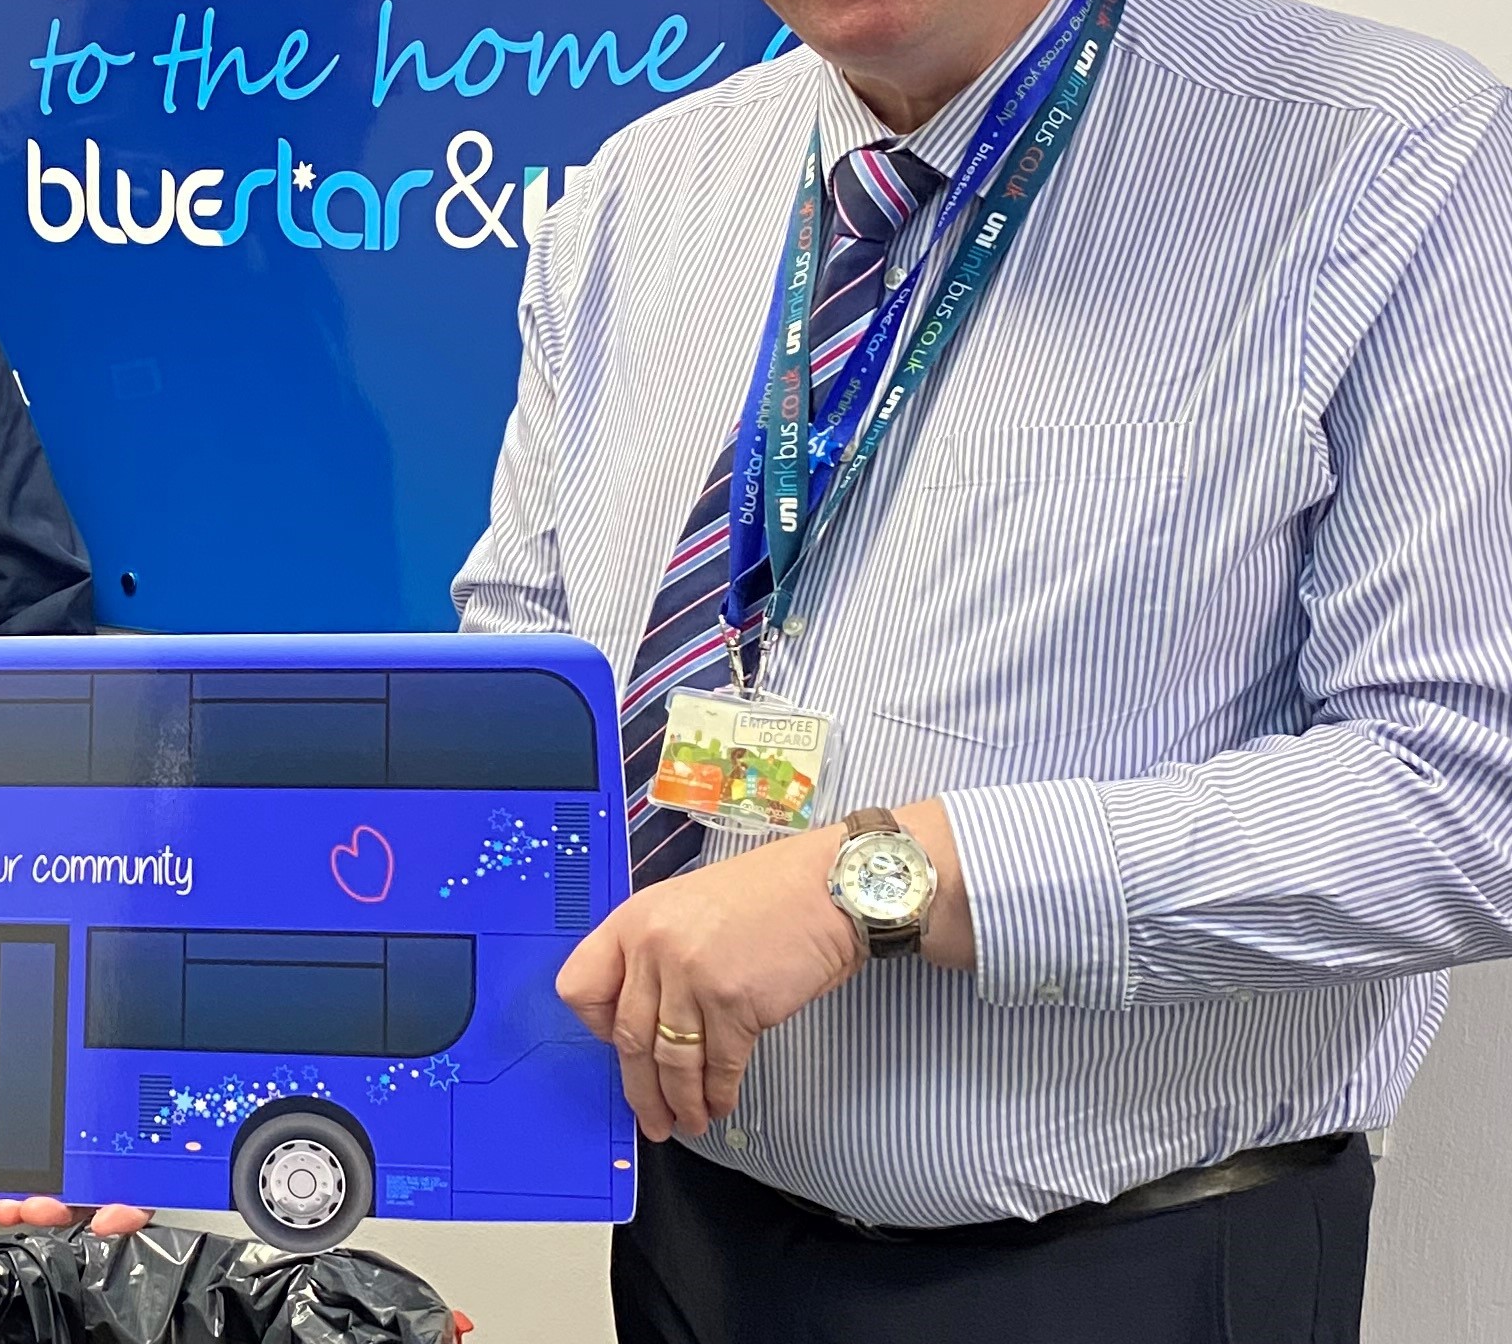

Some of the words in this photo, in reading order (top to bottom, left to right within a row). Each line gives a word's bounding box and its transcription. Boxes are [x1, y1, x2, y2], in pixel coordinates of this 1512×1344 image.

[30, 18, 135, 115] to
[153, 7, 339, 114] the
[372, 0, 726, 109] home
[1037, 30, 1073, 71] across
[1015, 67, 1041, 100] your
[995, 99, 1018, 127] city
[937, 142, 995, 228] bluestarbus
[865, 287, 911, 362] bluestar
[827, 376, 862, 426] shining
[739, 448, 763, 525] bluestar
[740, 717, 813, 733] EMPLOYEE
[32, 845, 194, 896] community
